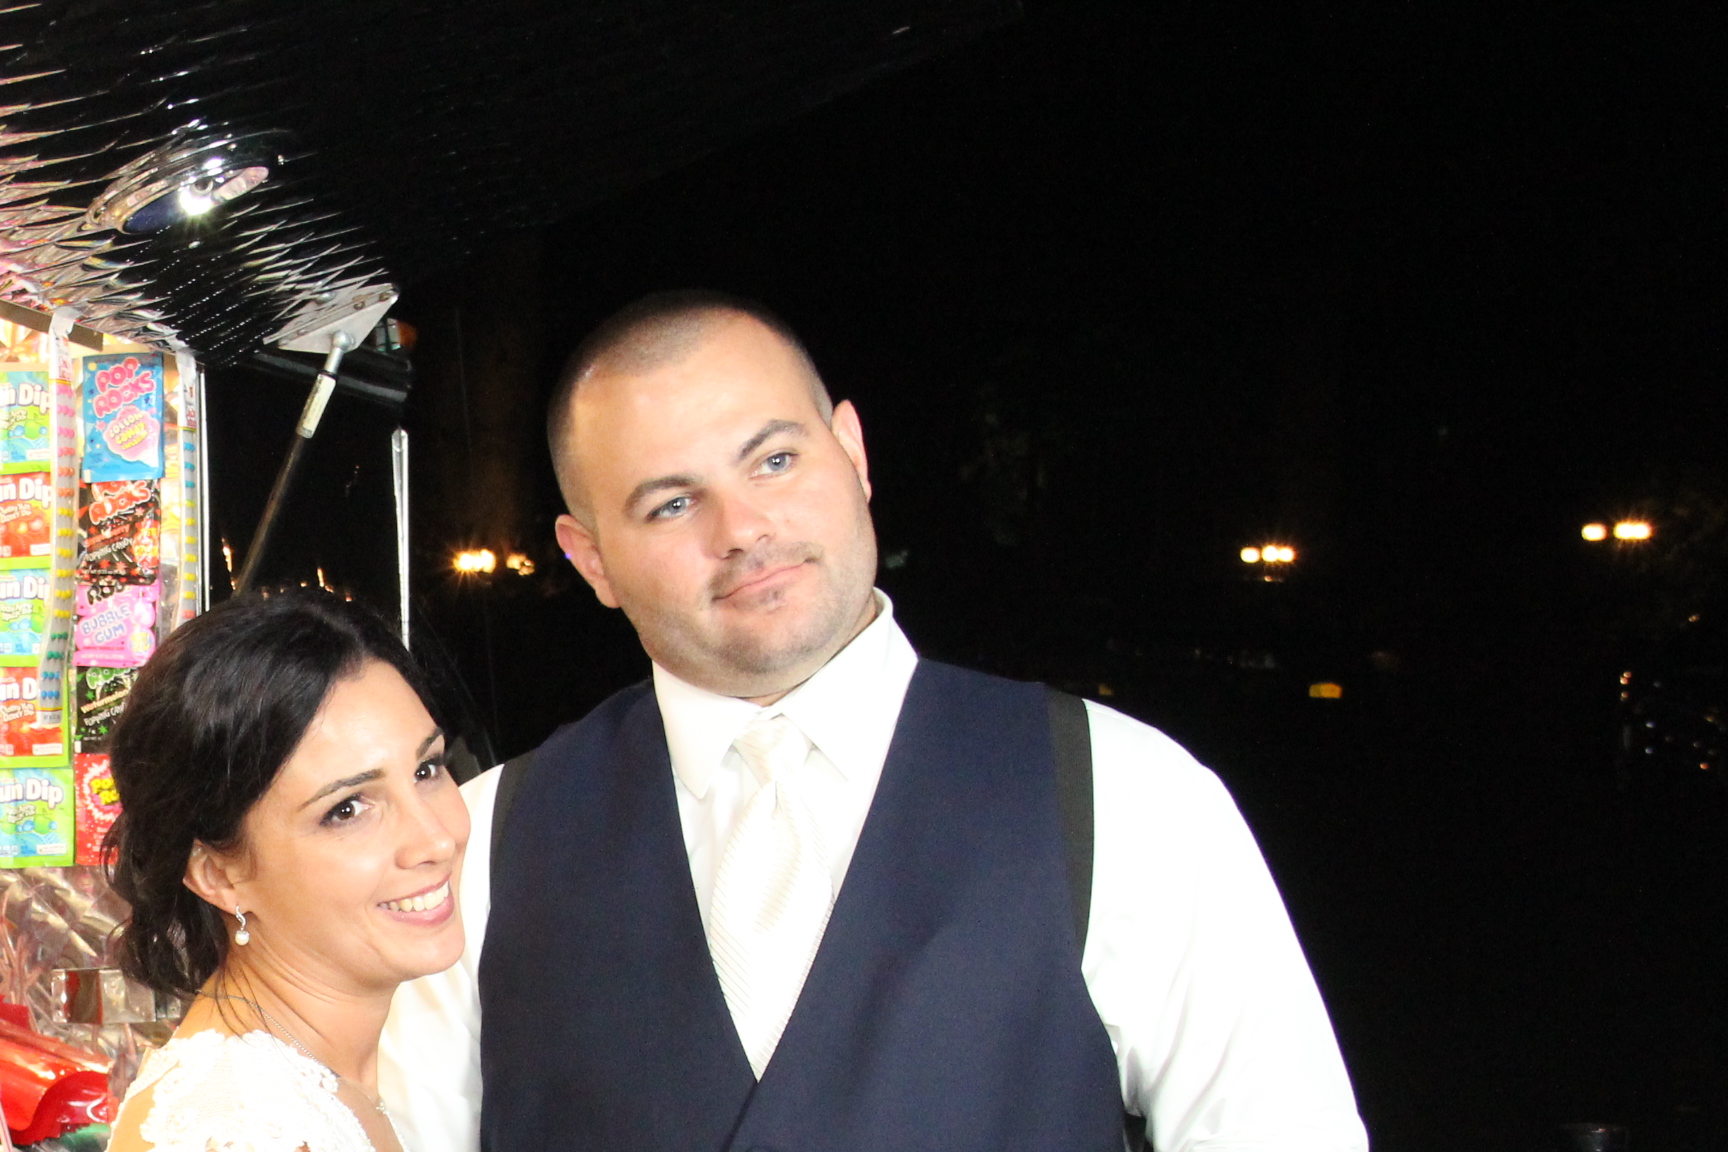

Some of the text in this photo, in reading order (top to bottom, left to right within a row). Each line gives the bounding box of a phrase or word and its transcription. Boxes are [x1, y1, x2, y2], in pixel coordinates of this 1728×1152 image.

[20, 477, 54, 510] Dip
[81, 604, 133, 636] BUBBLE
[94, 623, 127, 645] GUM
[26, 778, 64, 810] Dip
